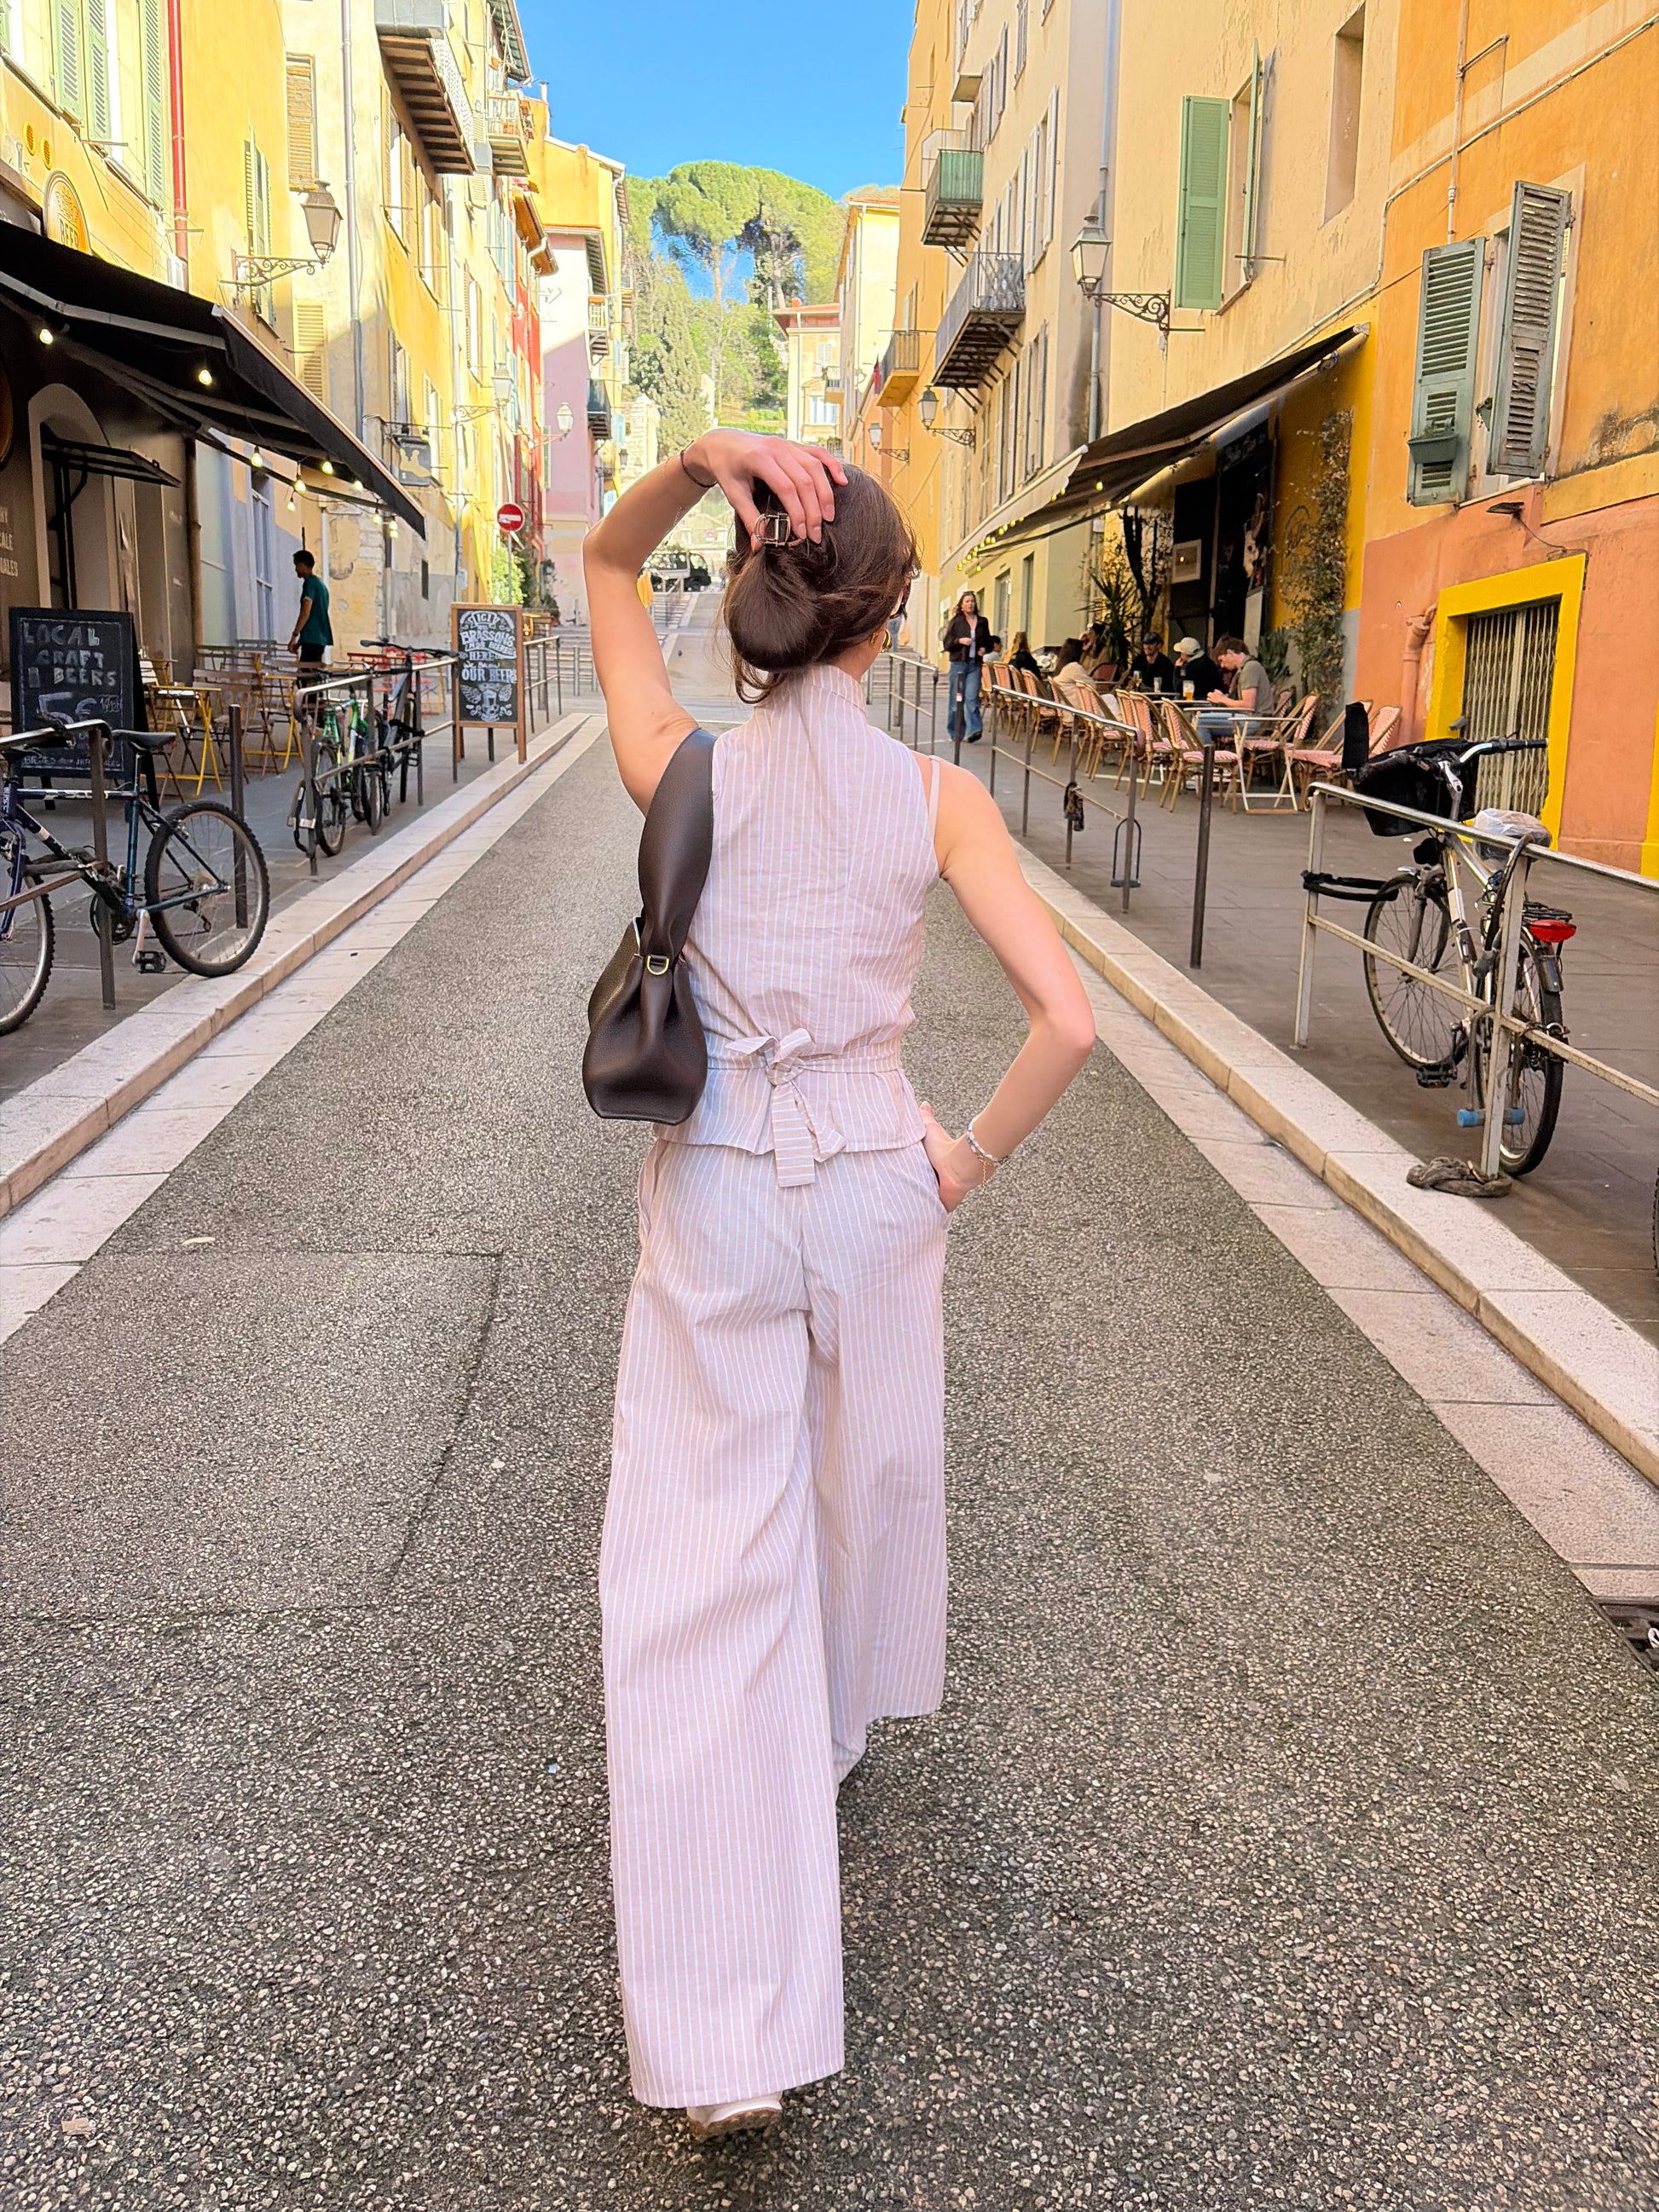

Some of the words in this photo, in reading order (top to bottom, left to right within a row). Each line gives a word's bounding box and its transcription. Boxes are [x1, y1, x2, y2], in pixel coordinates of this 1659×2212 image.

[23, 622, 100, 647] LOCAL
[460, 630, 515, 647] BRASSONS
[36, 650, 103, 668] CRAFT
[469, 651, 494, 661] HERE
[53, 667, 116, 685] BEERS
[461, 668, 485, 681] OUR
[489, 668, 517, 684] BEERS
